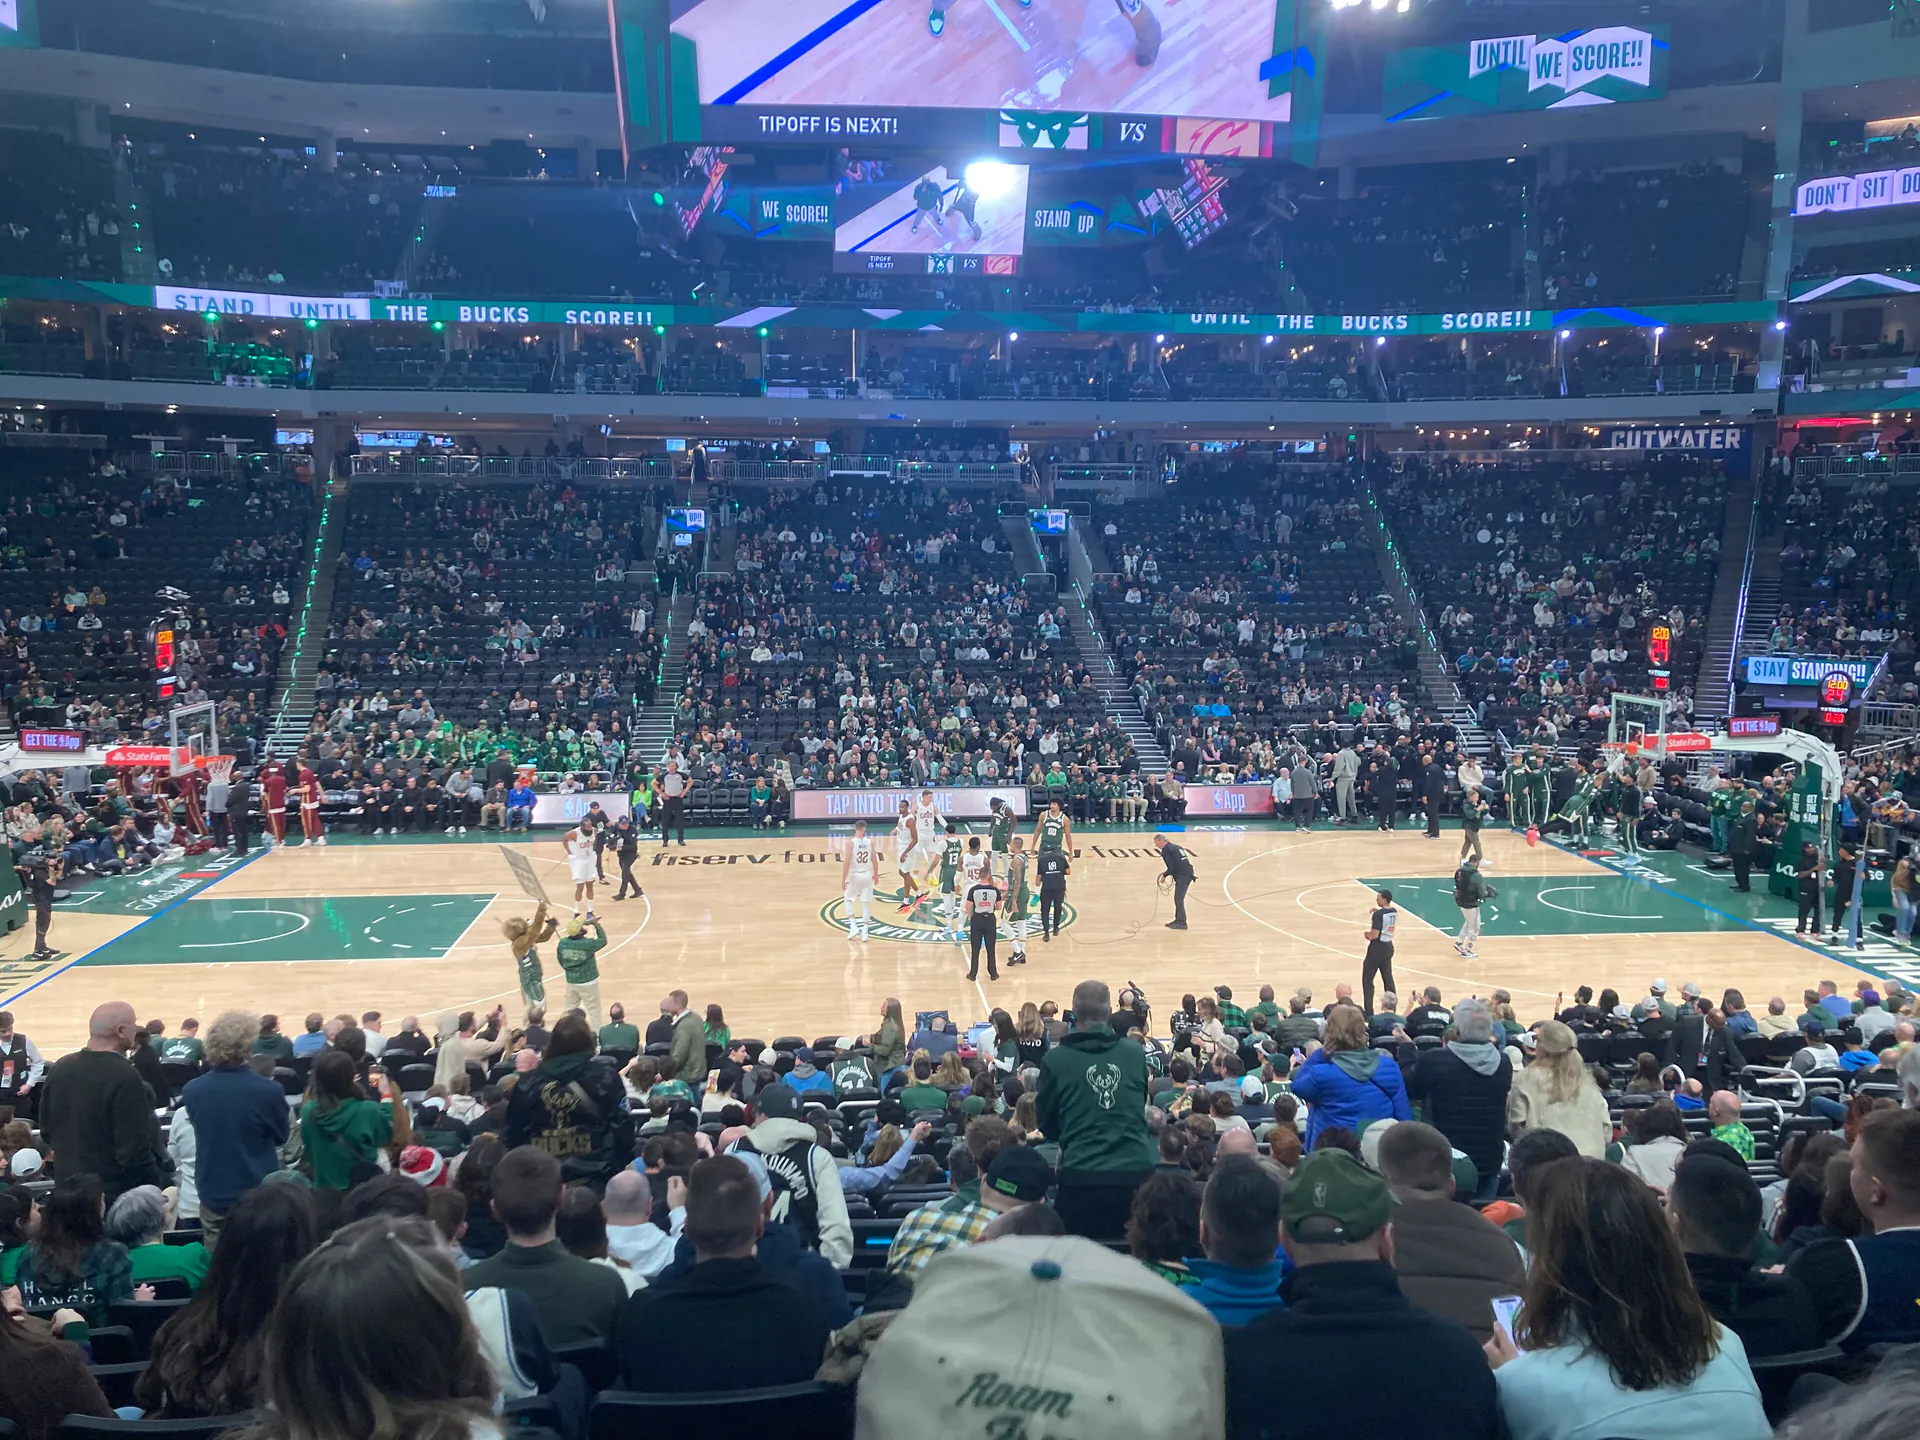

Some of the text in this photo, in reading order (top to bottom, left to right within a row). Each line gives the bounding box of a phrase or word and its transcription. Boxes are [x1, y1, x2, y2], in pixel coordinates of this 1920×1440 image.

[1477, 40, 1643, 79] UNTIL WE SCORE!!
[759, 116, 898, 134] TIPOFF IS NEXT!
[1120, 122, 1146, 141] VS
[1805, 182, 1850, 207] DON'T
[1863, 176, 1887, 199] SIT
[763, 201, 829, 223] WE SCORE!!
[1035, 209, 1094, 233] STAND UP
[963, 259, 978, 269] VS
[175, 294, 653, 325] STAND UNTIL THE BUCKS SCORE!!
[1276, 315, 1314, 330] THE
[1341, 315, 1408, 331] BUCKS
[1441, 310, 1532, 330] SCORE!!
[1611, 428, 1741, 449] CUTWATER
[1754, 661, 1785, 678] STAY
[1828, 680, 1848, 690] 12:00
[1825, 689, 1844, 701] 24
[25, 734, 40, 746] GET
[42, 734, 57, 746] THE
[826, 794, 850, 815] TAP
[854, 794, 884, 815] INTO
[916, 792, 953, 813] GME
[1224, 796, 1246, 809] App
[1806, 794, 1817, 803] GET
[1806, 803, 1817, 813] THE
[857, 851, 868, 863] 32
[949, 852, 958, 865] 13
[982, 892, 988, 901] 3
[955, 1372, 1074, 1419] Roam
